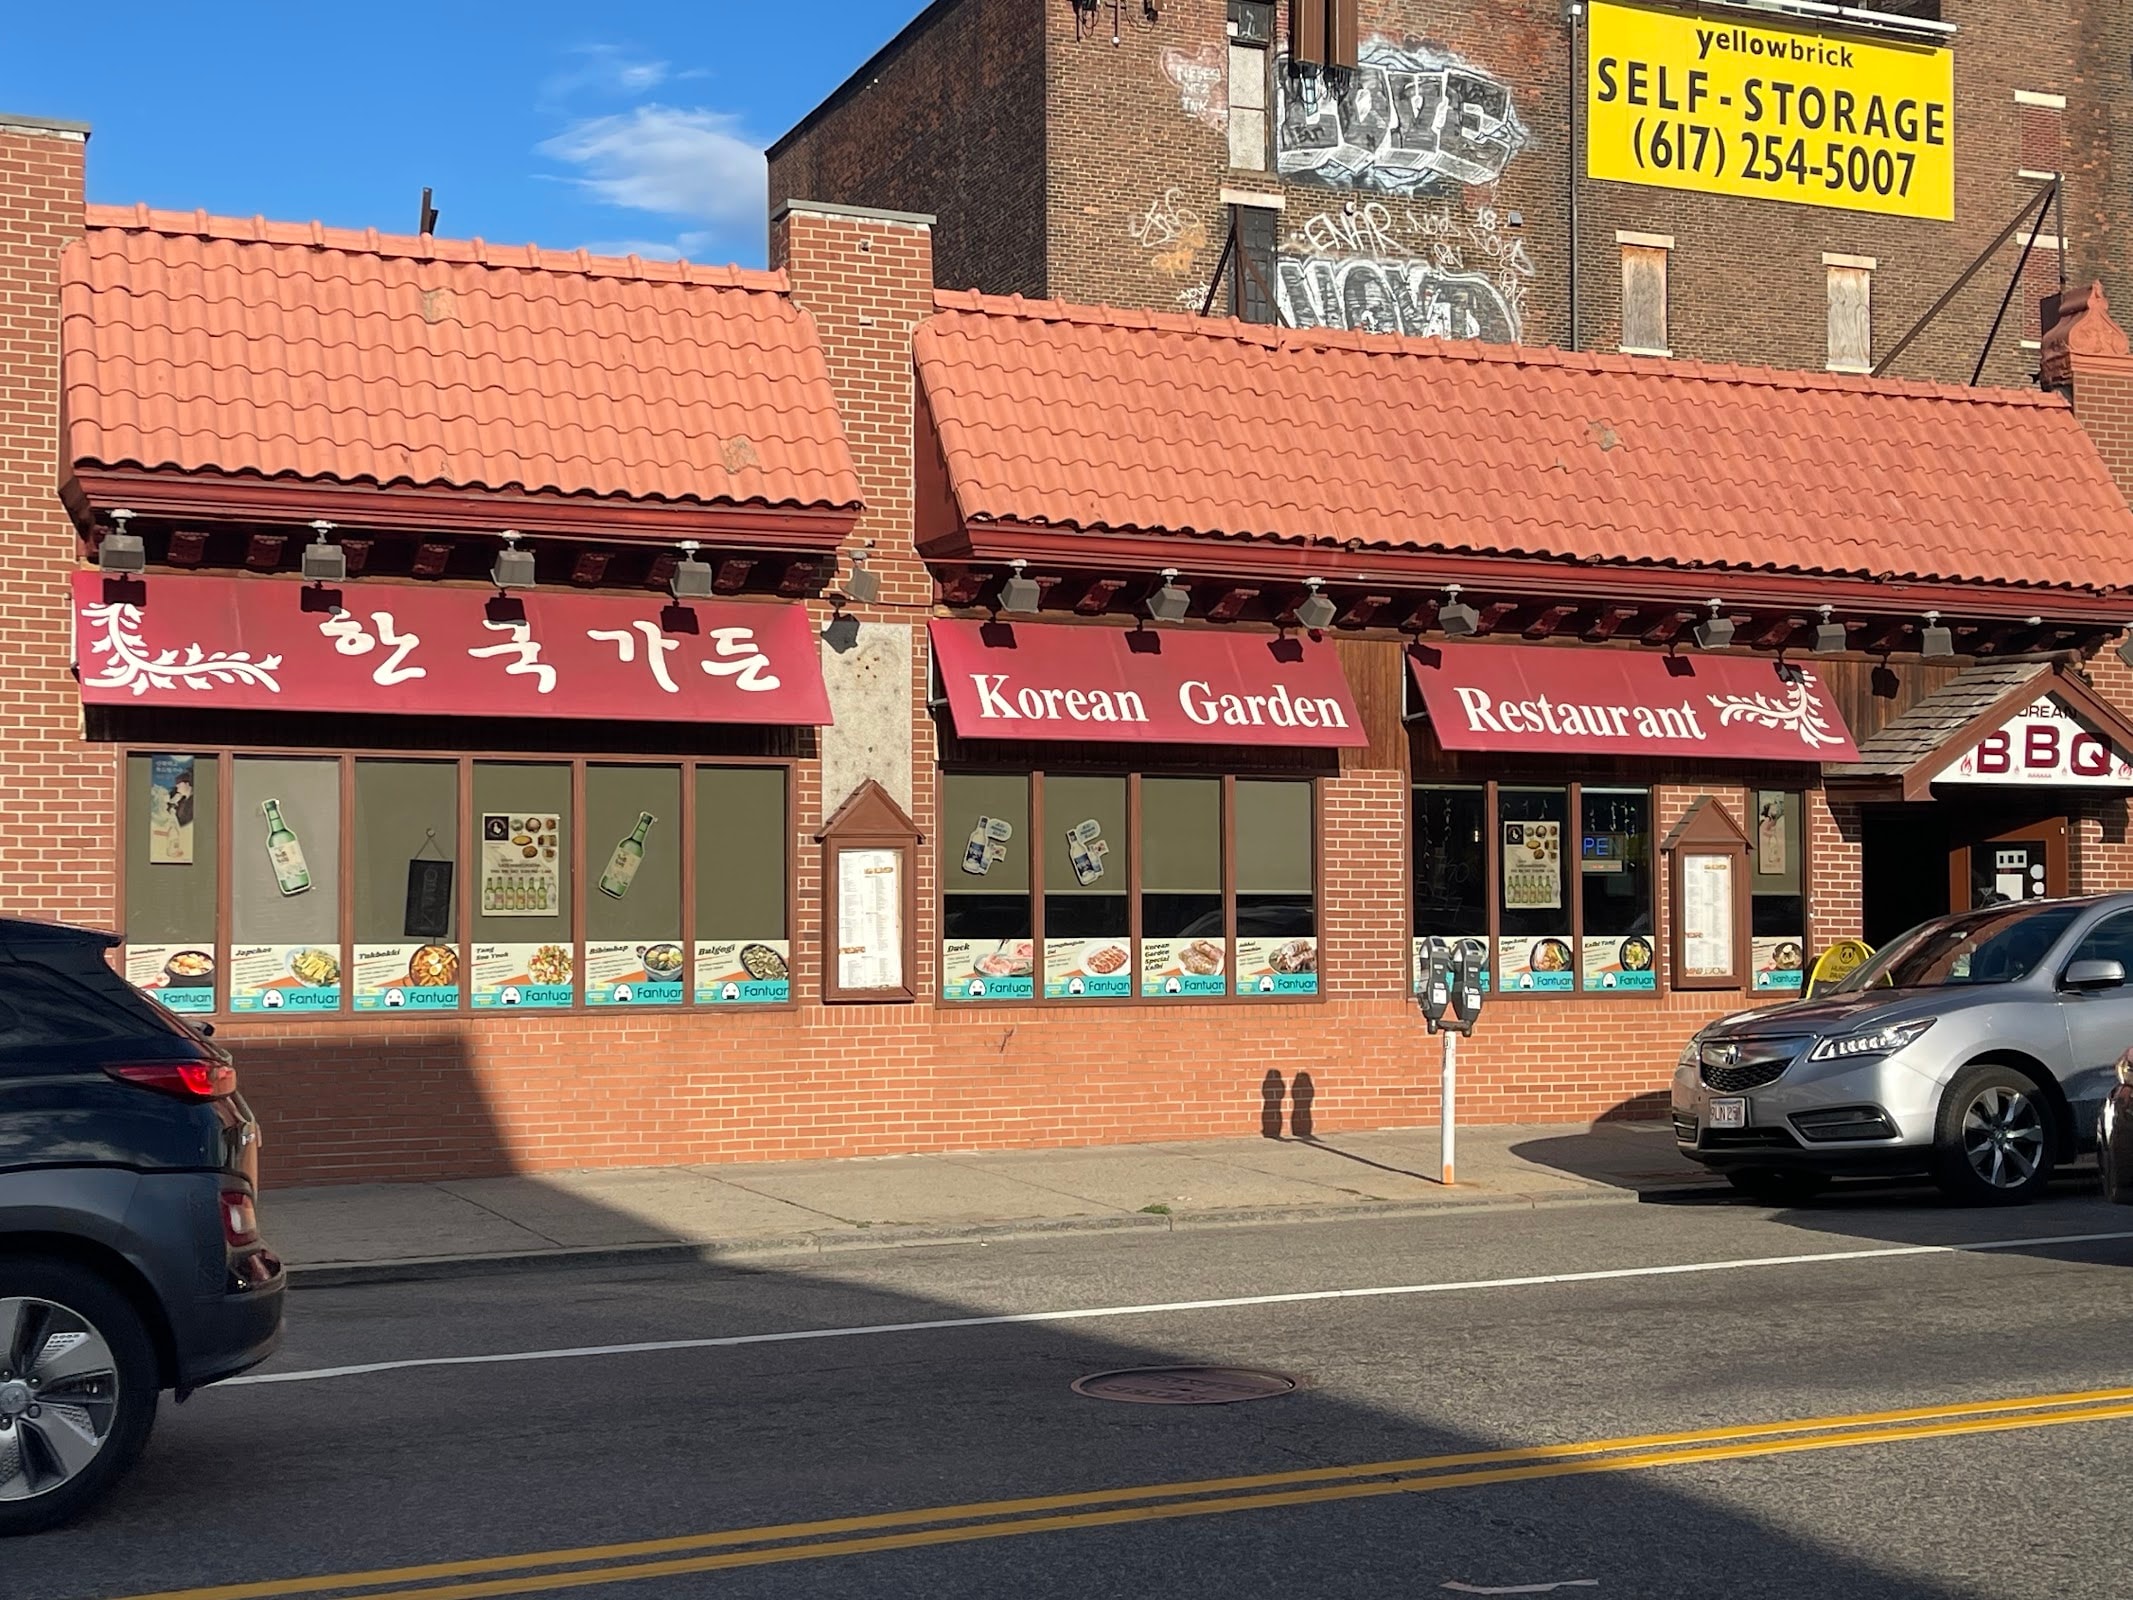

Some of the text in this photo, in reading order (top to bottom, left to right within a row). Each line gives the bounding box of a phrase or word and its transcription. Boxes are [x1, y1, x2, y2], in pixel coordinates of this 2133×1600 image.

[1696, 29, 1854, 68] yellowbrick
[1633, 117, 1916, 198] (617) 254-5007
[969, 673, 1350, 728] Korean Garden
[1453, 686, 1707, 740] Restaurant
[2017, 705, 2078, 719] OREAN
[1976, 724, 2114, 777] BBQ
[698, 943, 736, 956] Bulgogi
[947, 942, 970, 953] Duck
[1144, 943, 1170, 951] Korean
[1144, 950, 1170, 958] Garden
[1144, 956, 1170, 965] Special
[989, 982, 1033, 993] Fantuan
[1088, 981, 1130, 991] Fantuan
[1184, 980, 1225, 990] Fantuan
[1278, 979, 1317, 989] Fantuan
[163, 993, 212, 1003] Fantuan
